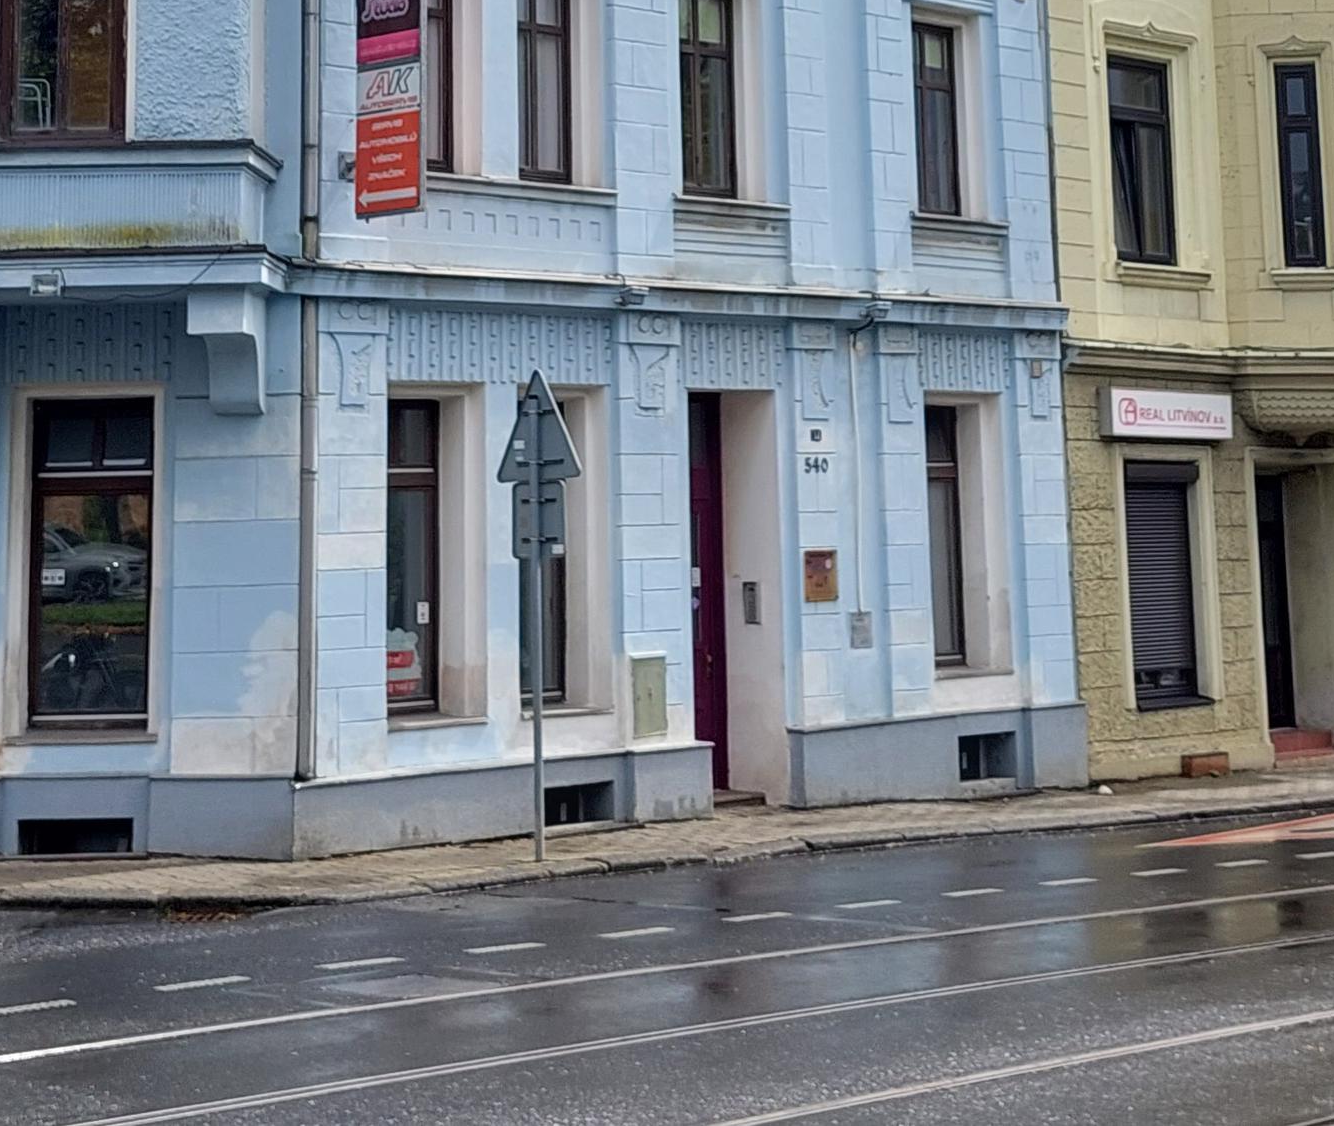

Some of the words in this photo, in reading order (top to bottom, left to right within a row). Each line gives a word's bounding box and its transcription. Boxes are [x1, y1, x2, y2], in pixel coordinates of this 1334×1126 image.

[366, 66, 415, 100] AK
[1139, 407, 1166, 421] REAL
[1167, 406, 1212, 424] LITVÍNOV
[804, 457, 829, 474] 540
